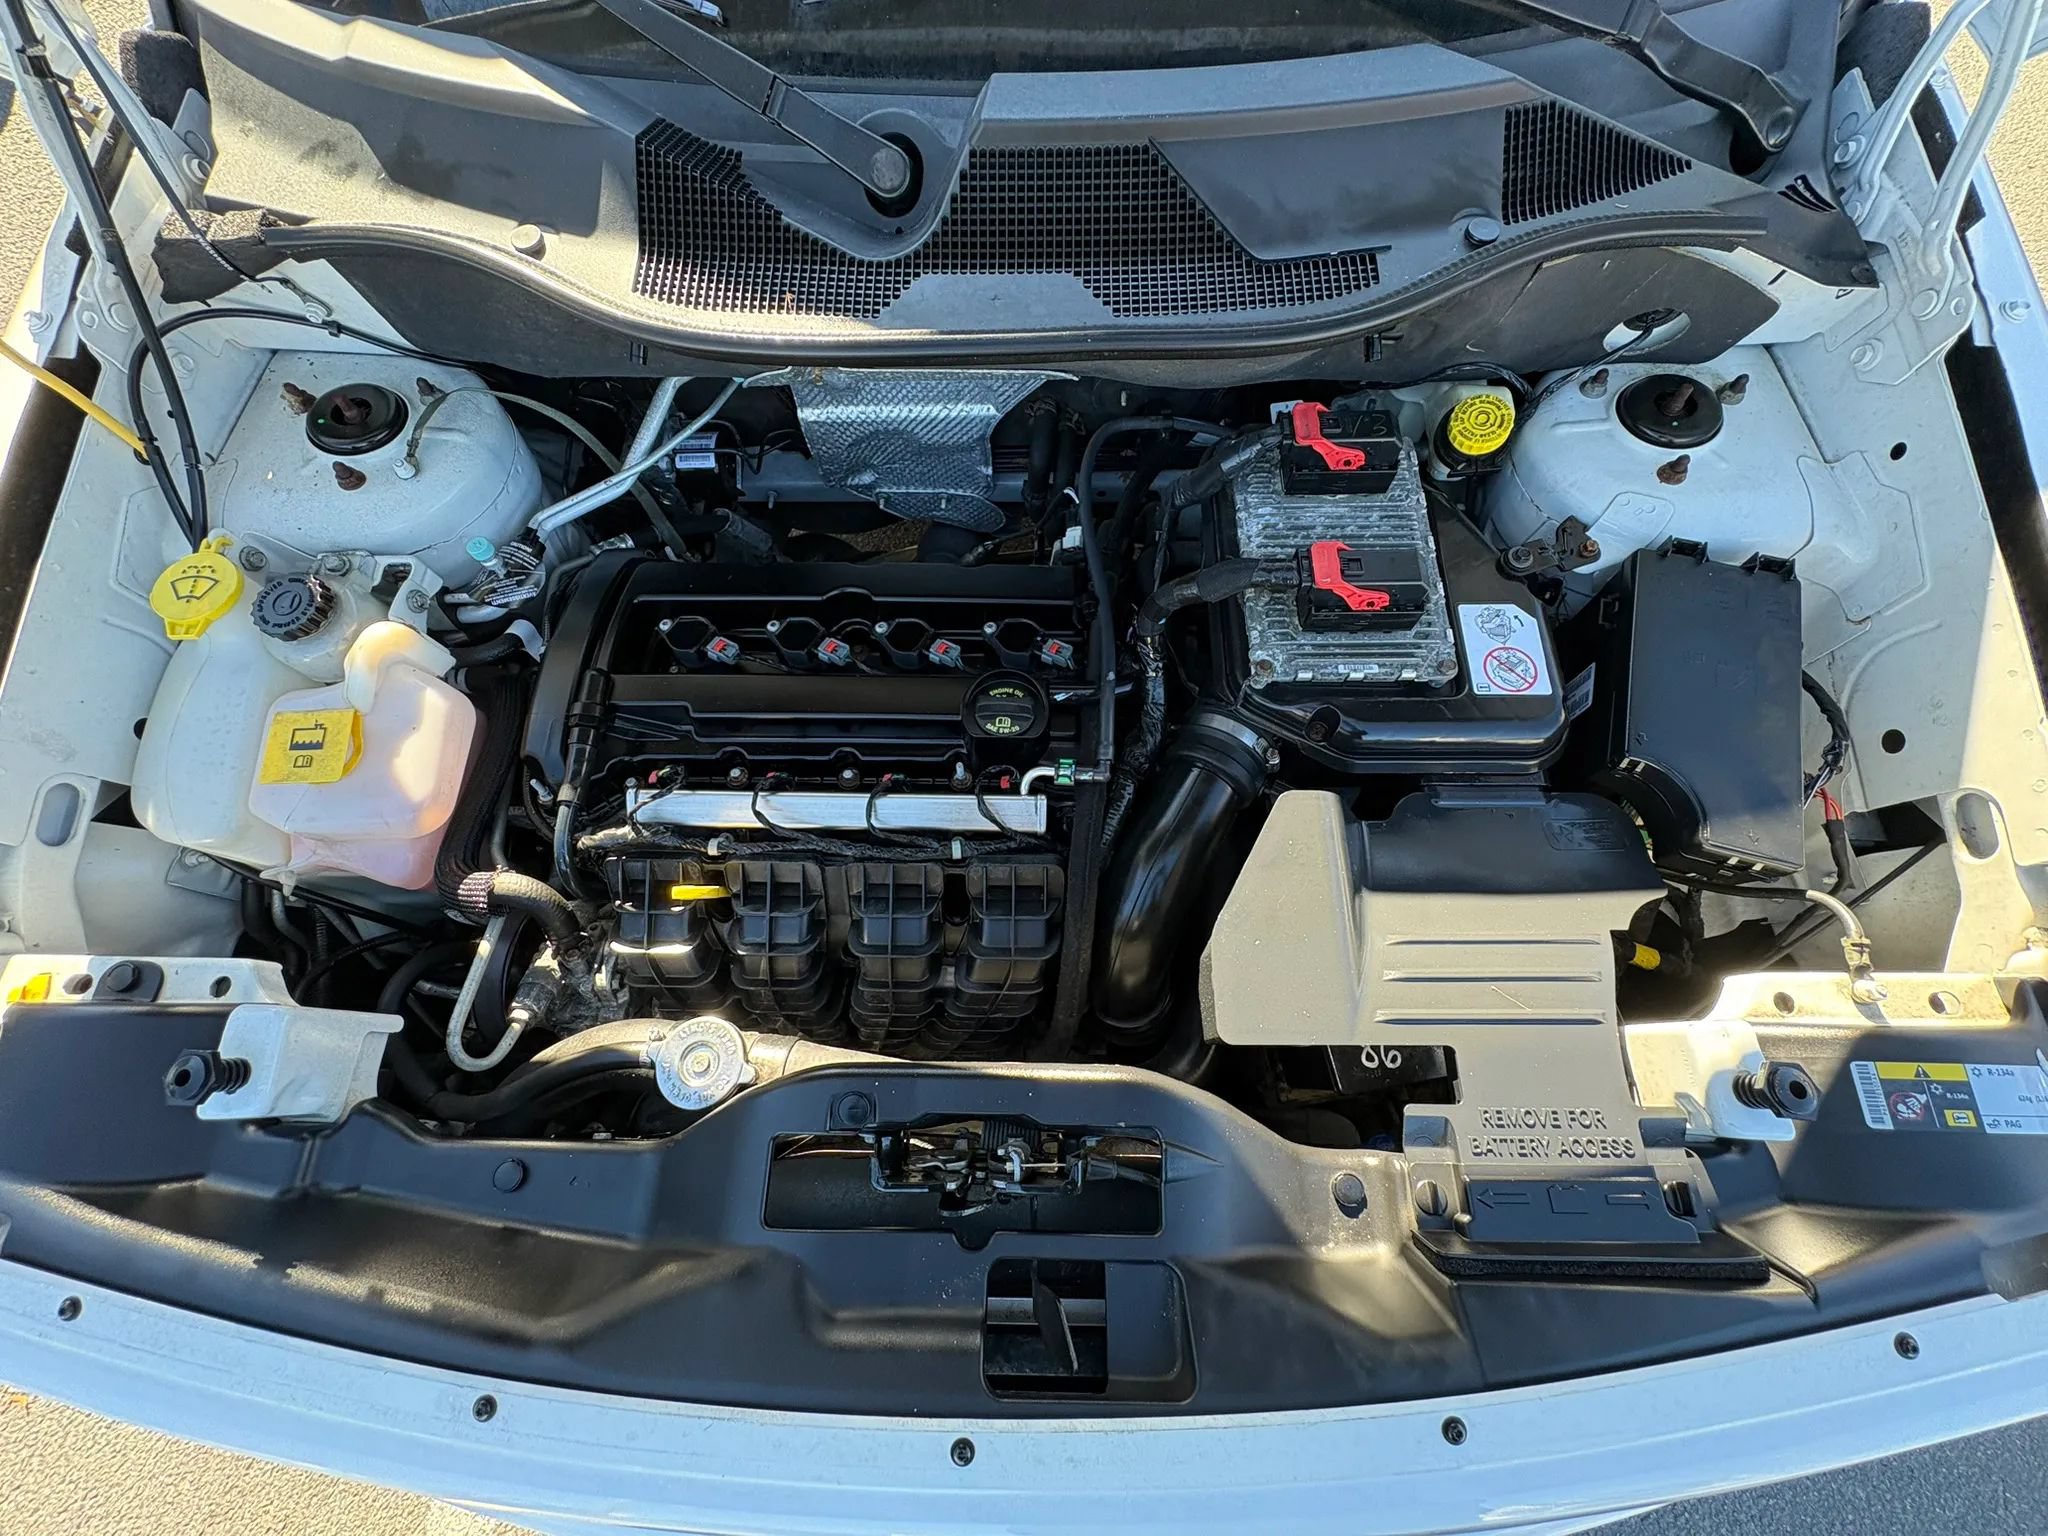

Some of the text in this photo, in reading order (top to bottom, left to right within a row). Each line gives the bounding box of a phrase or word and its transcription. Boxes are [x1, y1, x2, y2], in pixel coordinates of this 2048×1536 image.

[989, 688, 1024, 698] ENGINE OIL
[985, 723, 998, 732] SAE
[1987, 1068, 2015, 1077] R-134a
[1478, 1107, 1607, 1129] REMOVE FOR
[2004, 1119, 2023, 1129] PAG
[1468, 1136, 1636, 1158] BATTERY ACCESS
